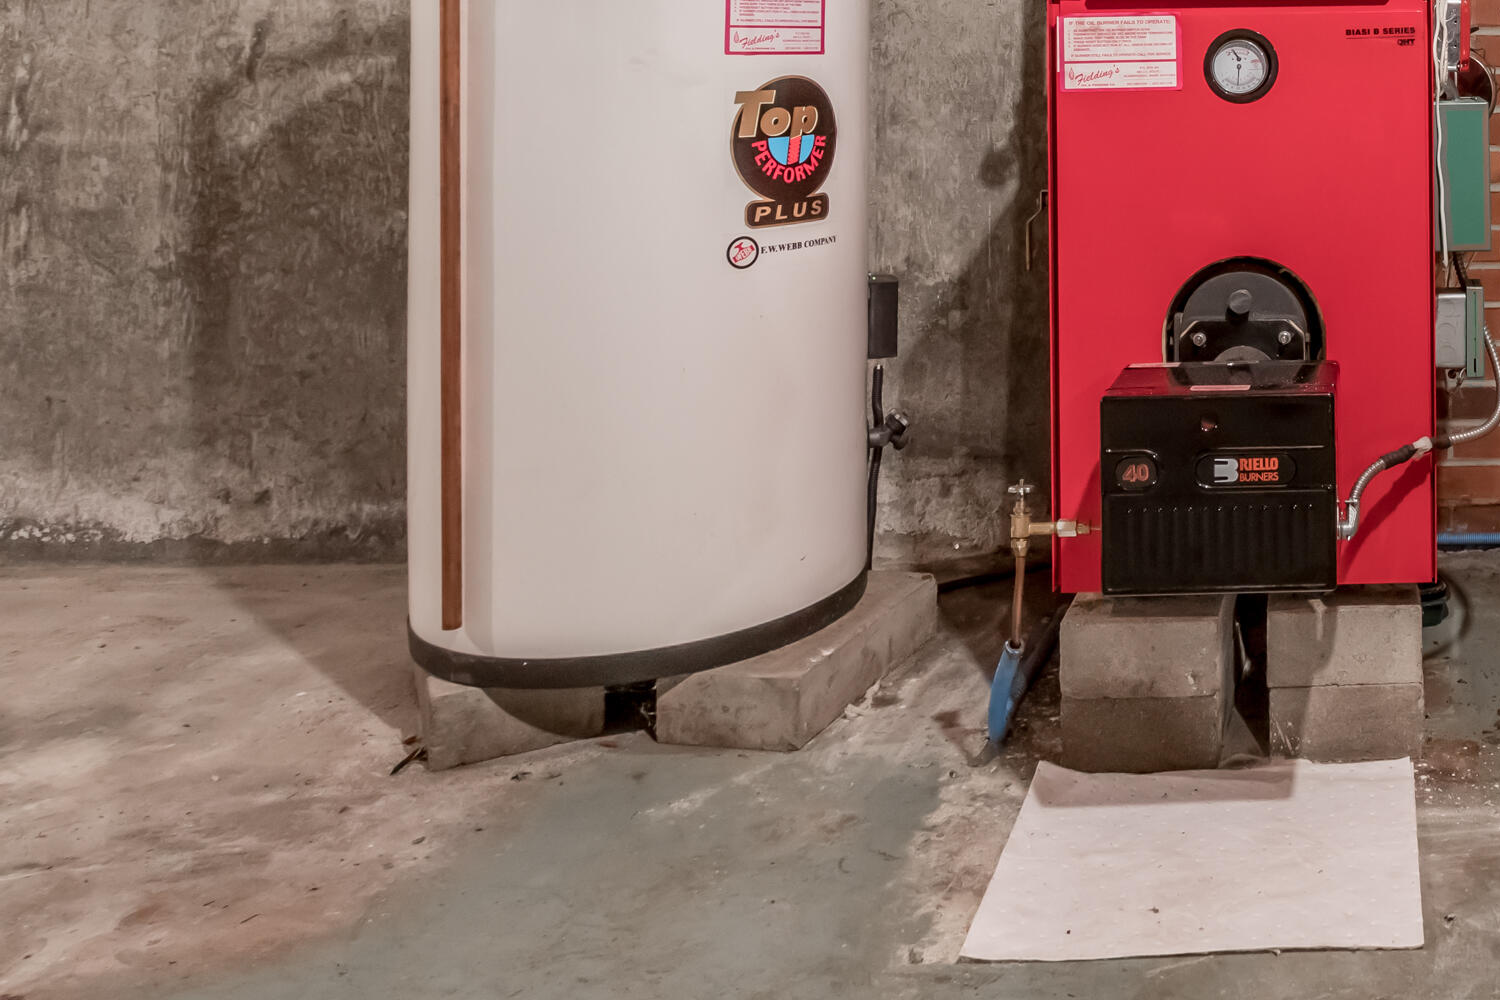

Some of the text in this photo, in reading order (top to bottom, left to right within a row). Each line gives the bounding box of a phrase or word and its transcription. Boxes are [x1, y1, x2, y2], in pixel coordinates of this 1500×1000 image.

[739, 30, 780, 48] Fielding's
[1345, 28, 1370, 36] BIASI
[1383, 27, 1415, 35] SERIES
[1075, 64, 1120, 86] Fielding's
[734, 89, 818, 140] Top
[751, 135, 827, 184] PERFORMER
[754, 200, 822, 222] PLUS
[779, 242, 802, 251] WEBB
[804, 235, 837, 248] COMPANY
[1122, 464, 1149, 482] 40
[1240, 457, 1279, 471] RIELLO
[1240, 472, 1279, 482] BURNERS
